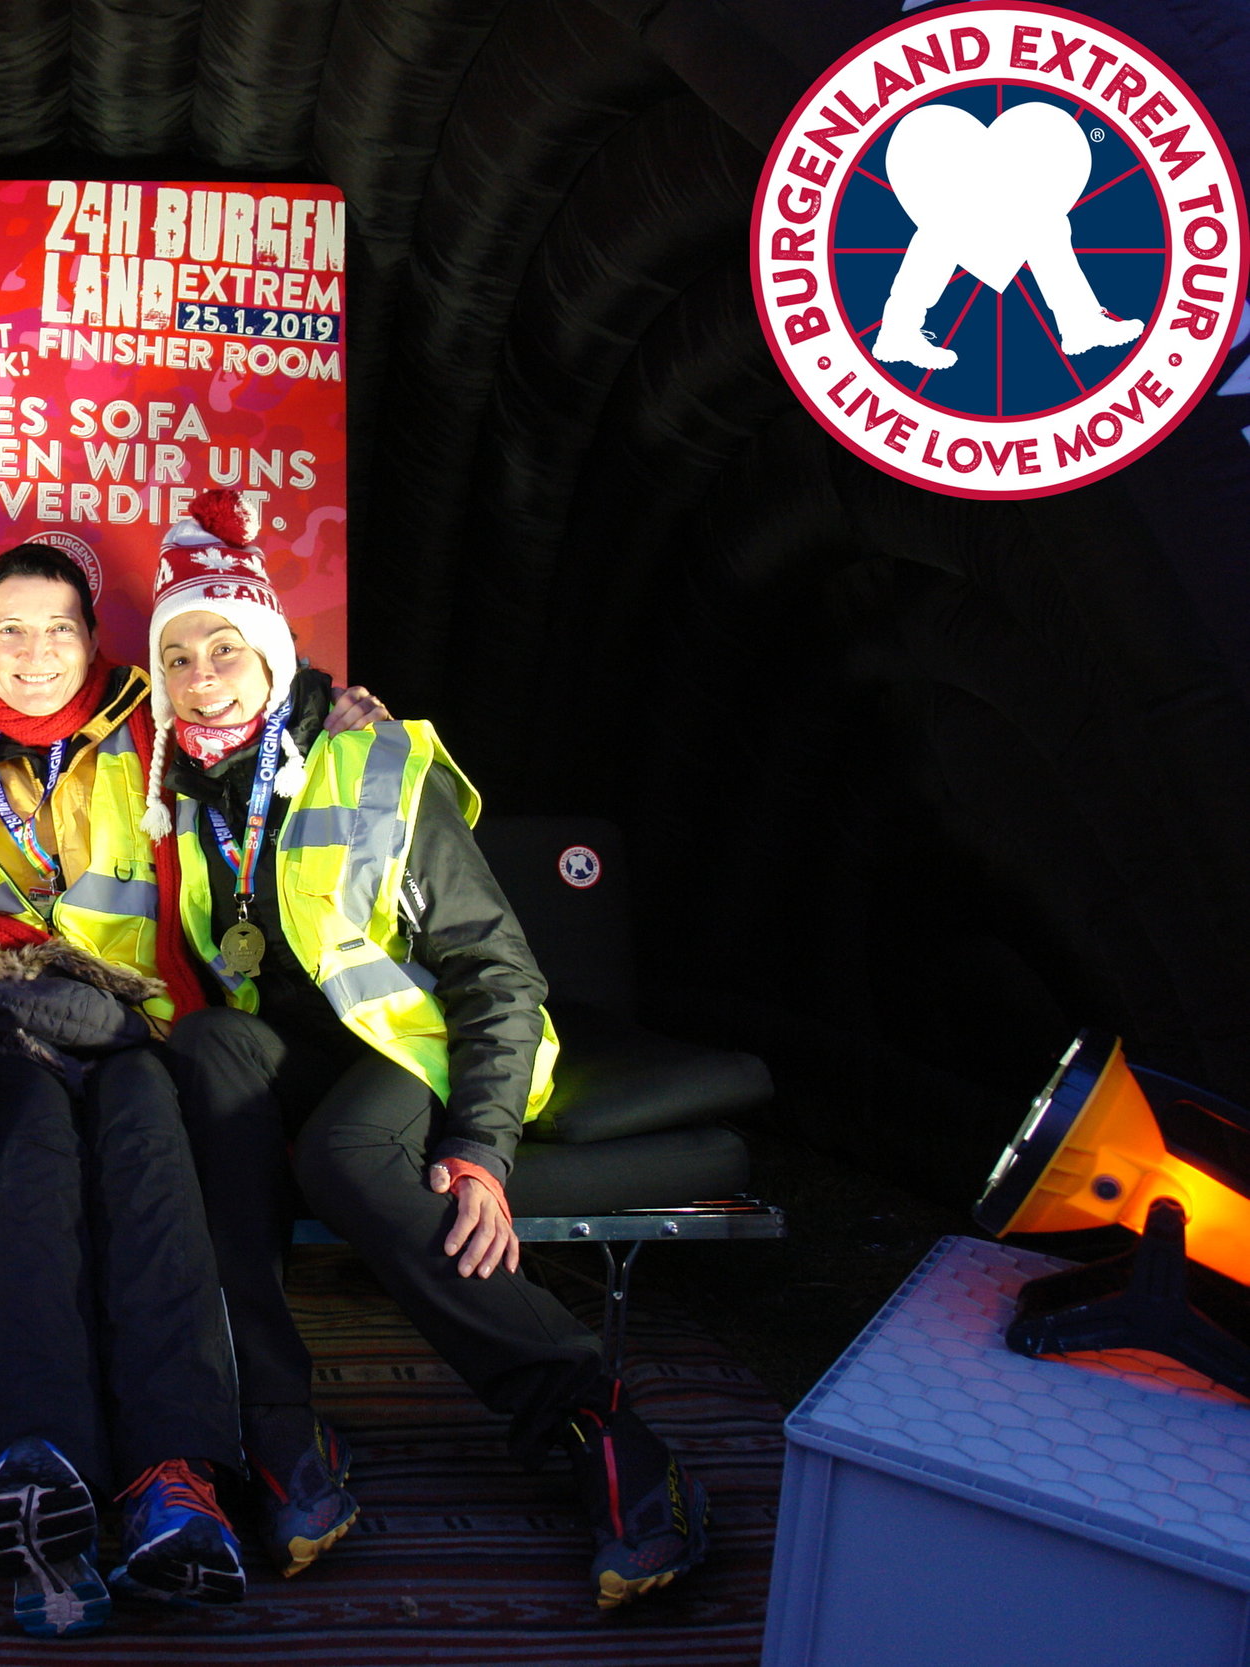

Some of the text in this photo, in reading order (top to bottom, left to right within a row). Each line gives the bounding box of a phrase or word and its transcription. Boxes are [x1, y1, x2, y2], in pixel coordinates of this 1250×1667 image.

[45, 181, 345, 272] 24H BURGEN
[41, 252, 341, 330] LAND EXTREM
[38, 328, 342, 382] FINISHER ROOM
[69, 398, 211, 443] SOFA
[83, 441, 186, 484] WIR
[209, 446, 317, 491] UNS
[50, 535, 99, 591] BURGENLAND
